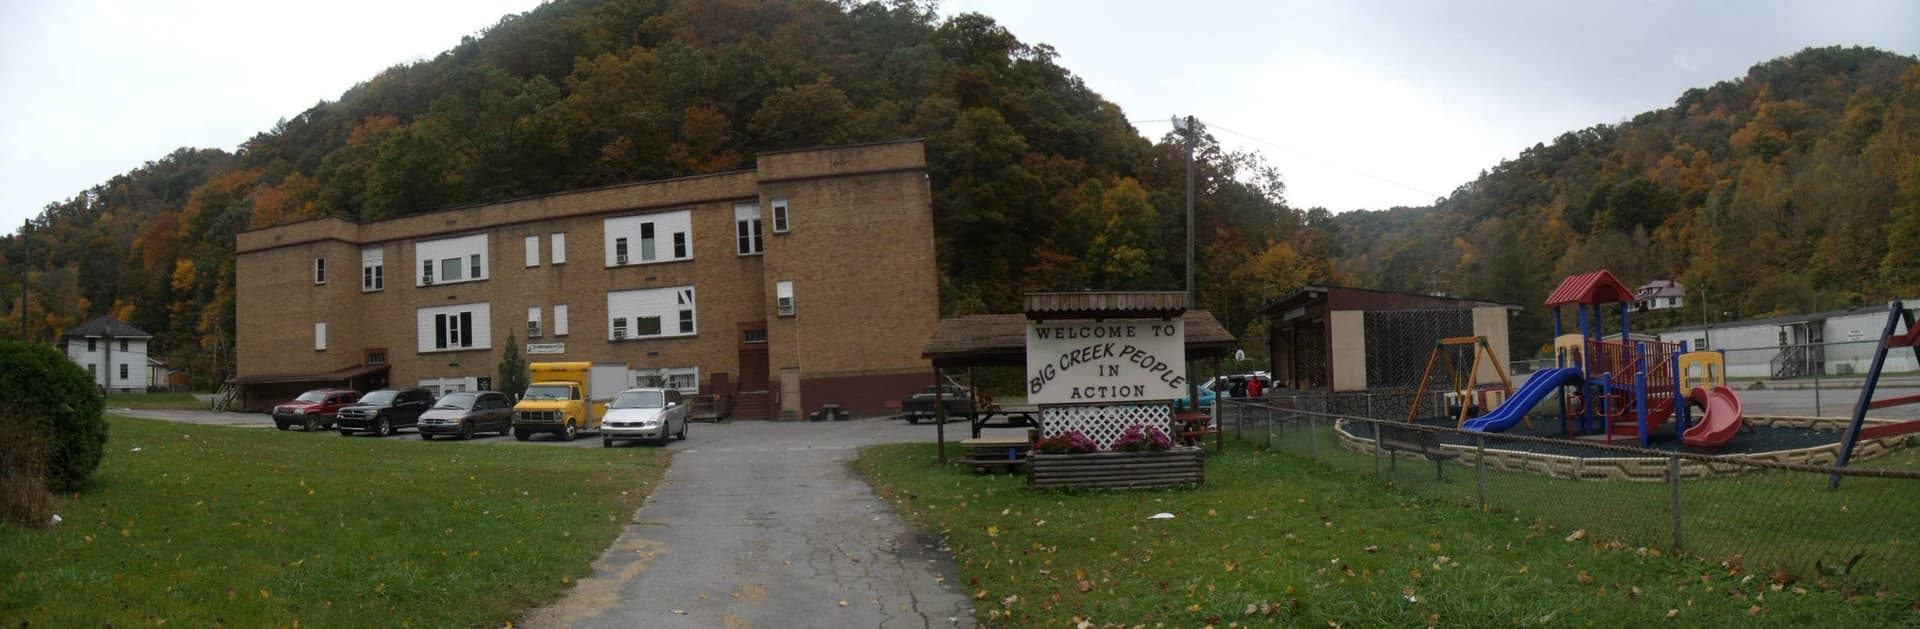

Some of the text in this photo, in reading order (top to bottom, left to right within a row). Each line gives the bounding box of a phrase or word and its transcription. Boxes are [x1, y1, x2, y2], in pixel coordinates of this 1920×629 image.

[1036, 324, 1176, 340] WELCOME TO
[1029, 342, 1186, 395] BIG CREEK PEOPLE
[1099, 365, 1120, 377] IN
[1070, 385, 1145, 399] ACTION
